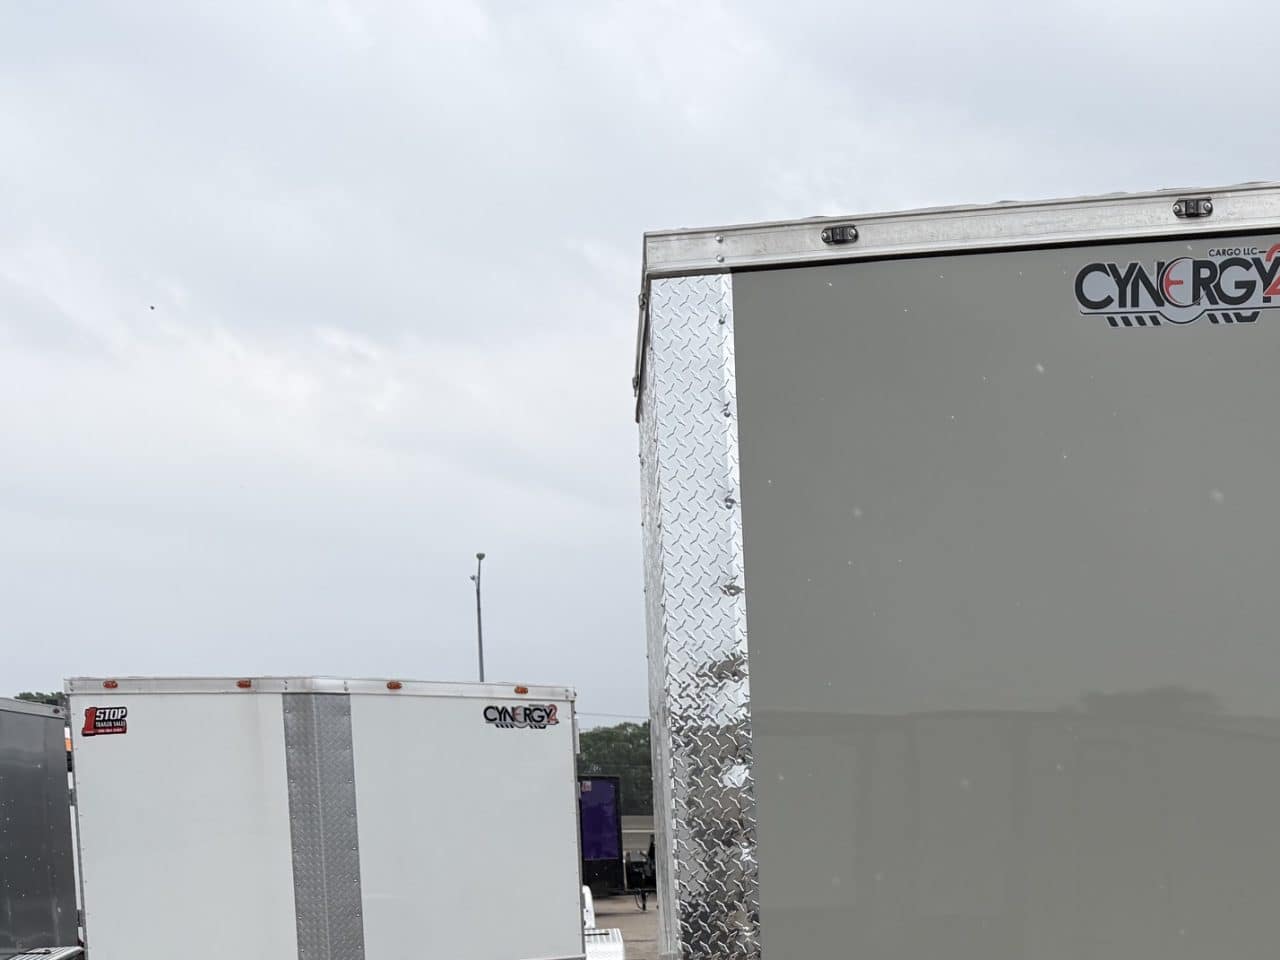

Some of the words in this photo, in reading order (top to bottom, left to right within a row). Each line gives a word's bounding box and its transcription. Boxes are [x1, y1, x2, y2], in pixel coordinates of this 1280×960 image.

[1208, 247, 1241, 257] CARGO
[1243, 247, 1258, 256] LLC
[96, 708, 125, 720] STOP
